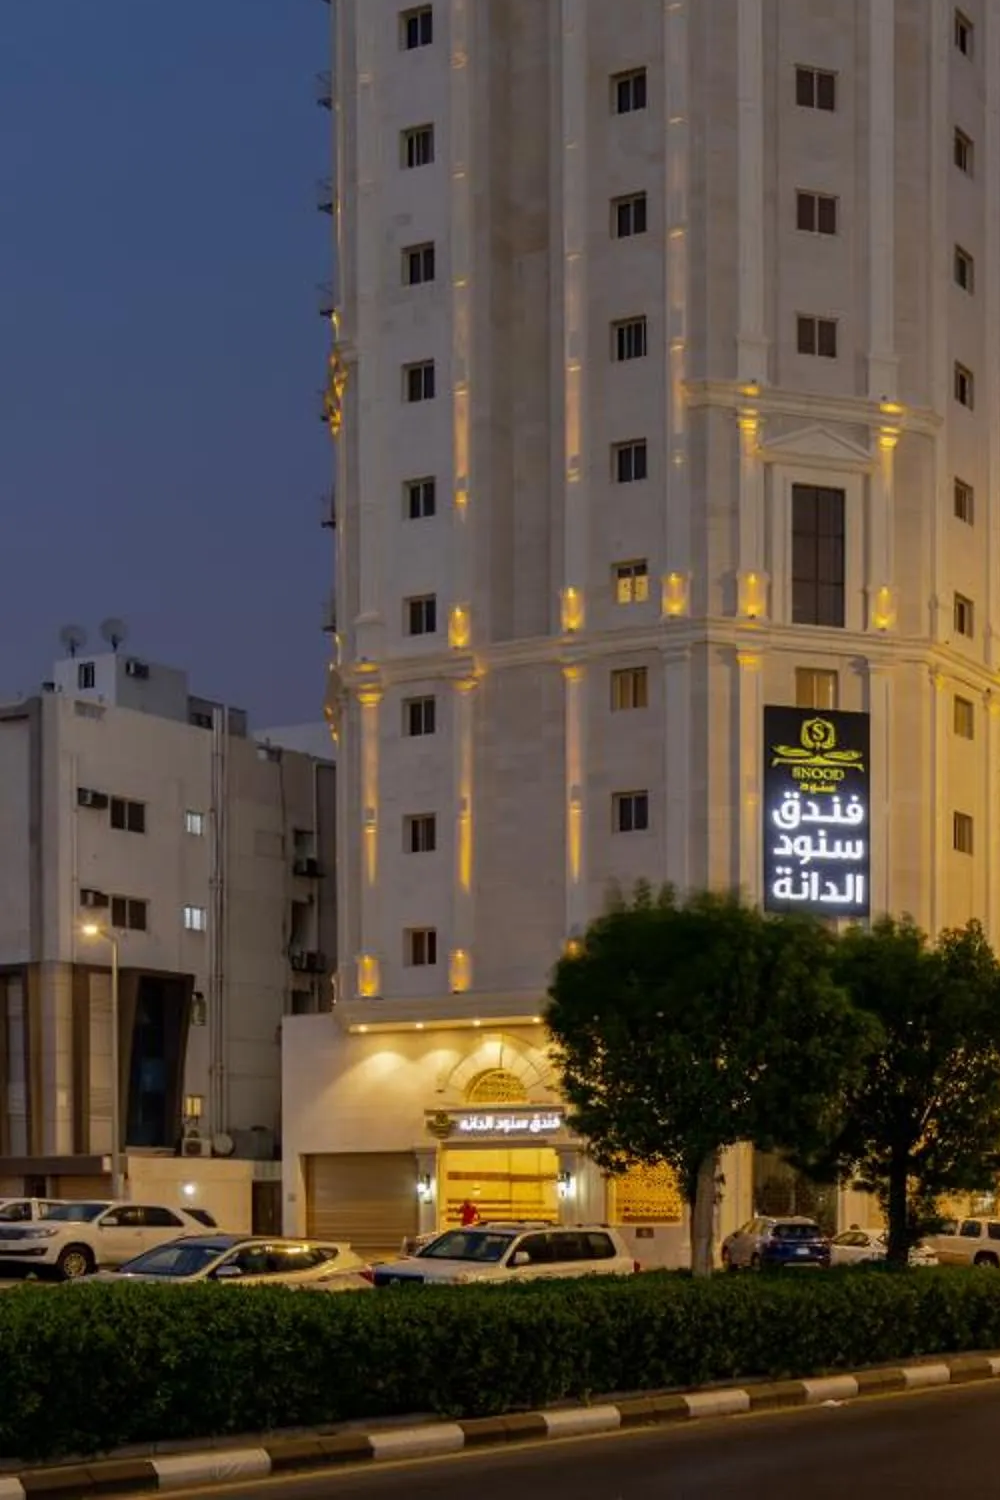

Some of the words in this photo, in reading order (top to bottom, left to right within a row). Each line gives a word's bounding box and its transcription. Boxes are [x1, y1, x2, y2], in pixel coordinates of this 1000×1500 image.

[812, 723, 825, 741] S
[792, 766, 845, 780] SNOOD
[772, 791, 864, 829] فندق
[773, 829, 864, 864] سنود
[772, 866, 864, 904] الدانة
